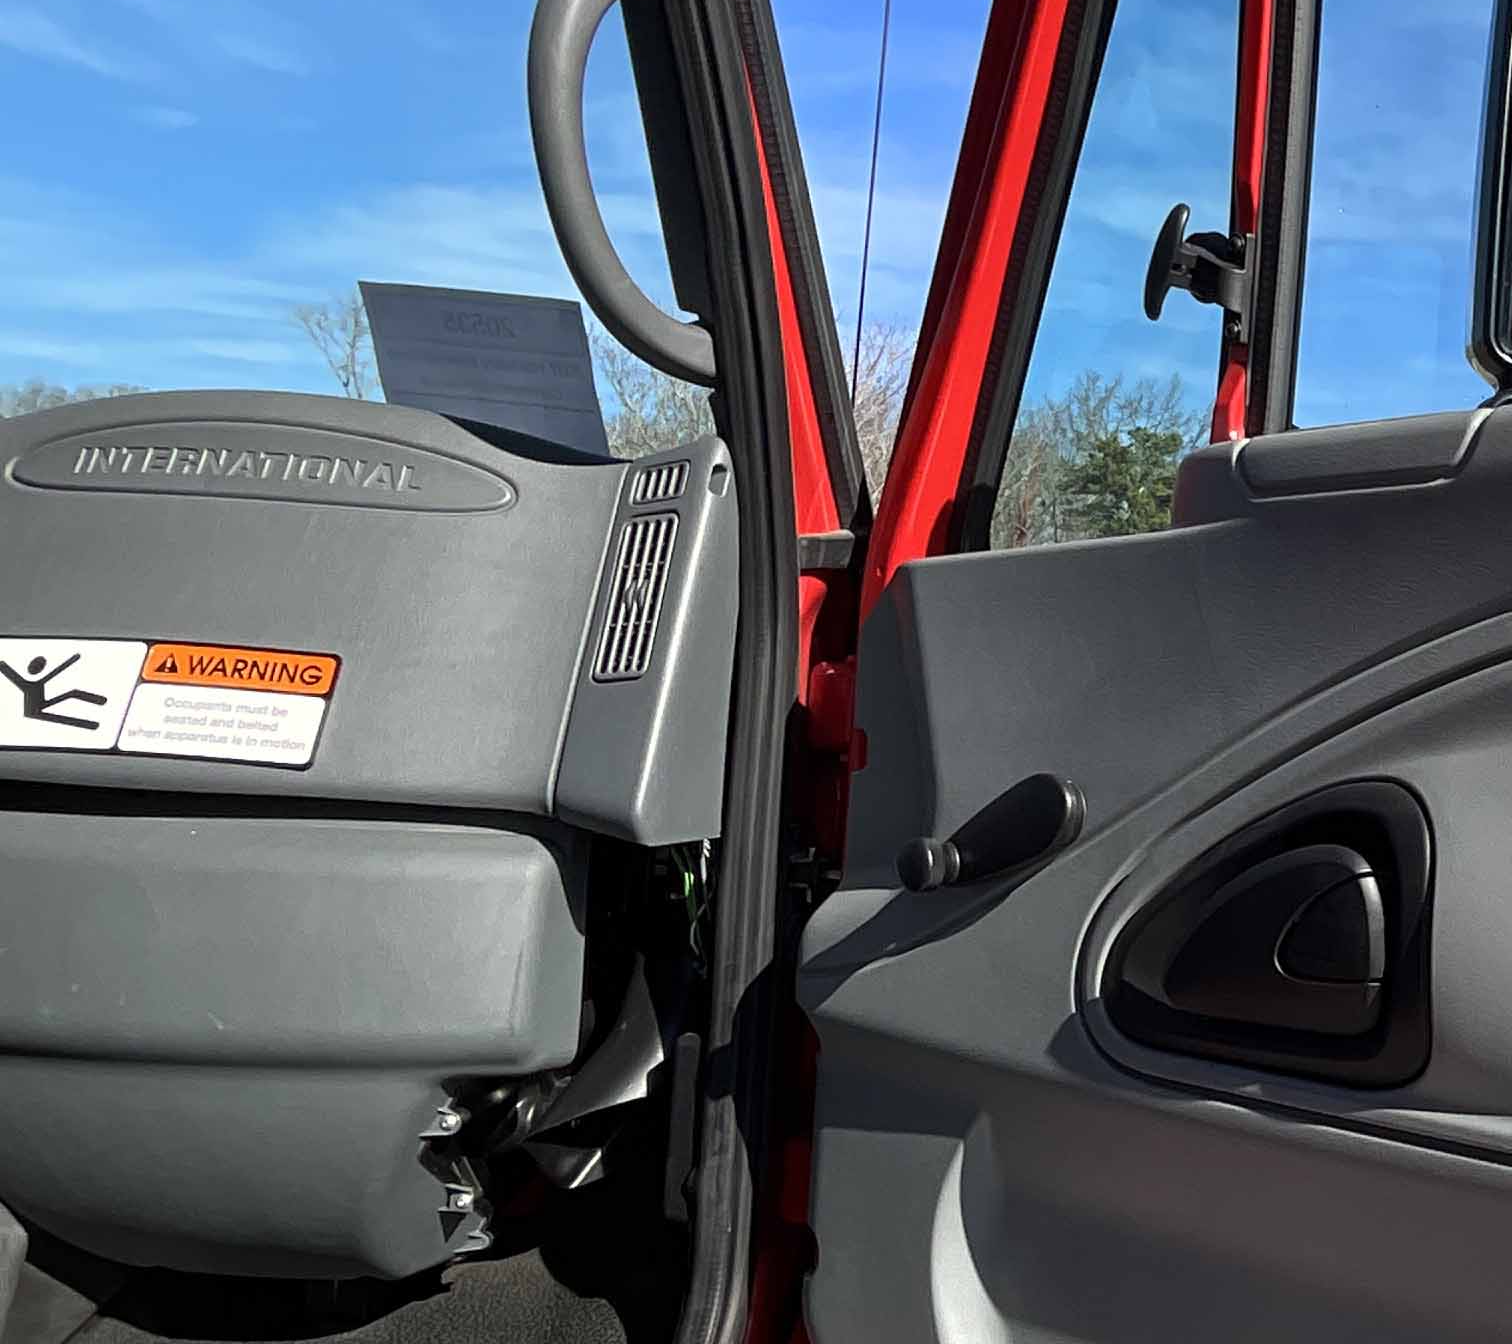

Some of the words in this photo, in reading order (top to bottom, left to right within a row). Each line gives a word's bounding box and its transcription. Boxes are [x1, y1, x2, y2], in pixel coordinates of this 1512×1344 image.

[73, 446, 422, 492] INTERNATIONAL
[188, 655, 323, 686] WARNING
[163, 696, 233, 715] Occupants
[235, 704, 269, 715] must
[271, 703, 289, 717] be
[163, 714, 208, 728] seated
[210, 715, 236, 729] and
[238, 718, 279, 732] belted
[127, 726, 161, 739] when
[163, 730, 229, 747] apparatus
[231, 733, 243, 746] is
[245, 734, 257, 747] in
[260, 736, 306, 751] motion
